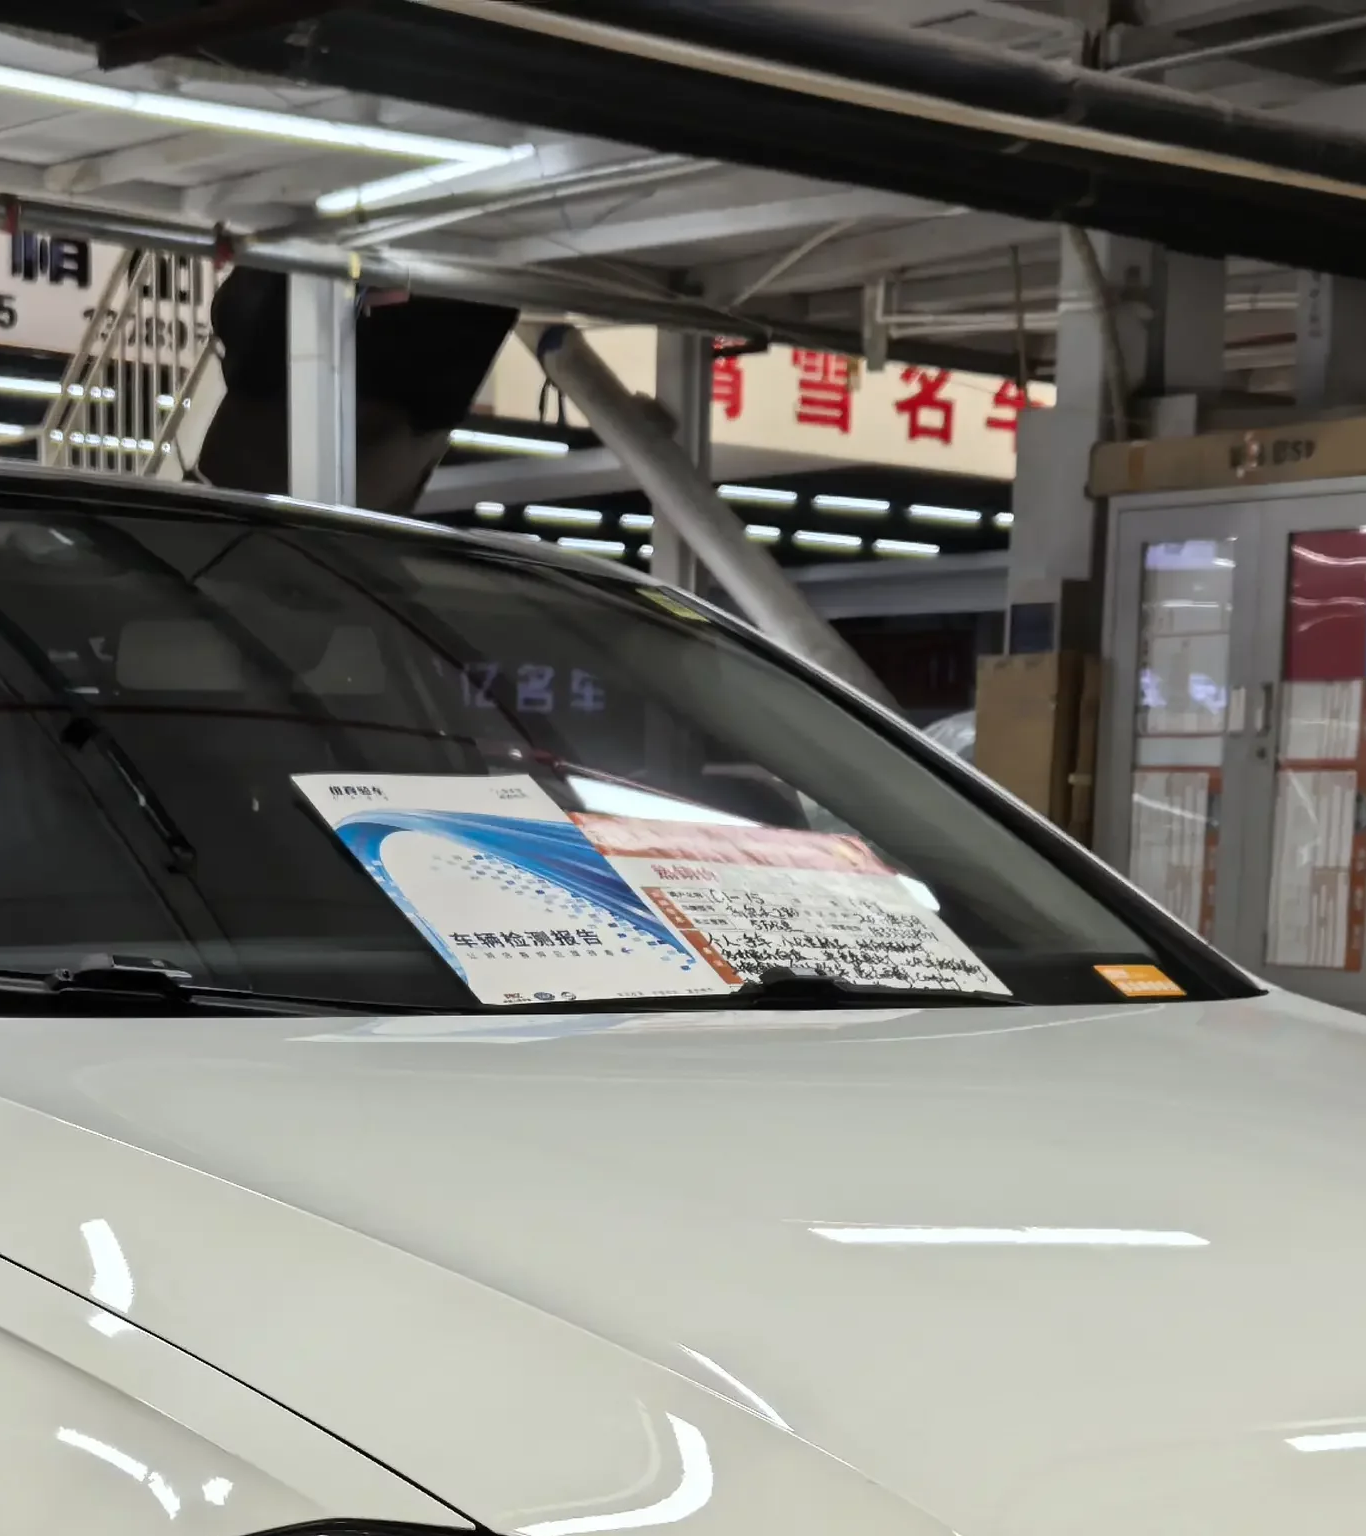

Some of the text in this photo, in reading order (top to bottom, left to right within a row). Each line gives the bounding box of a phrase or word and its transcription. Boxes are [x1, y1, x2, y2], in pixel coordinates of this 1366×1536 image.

[448, 928, 603, 949] 车辆检测报告
